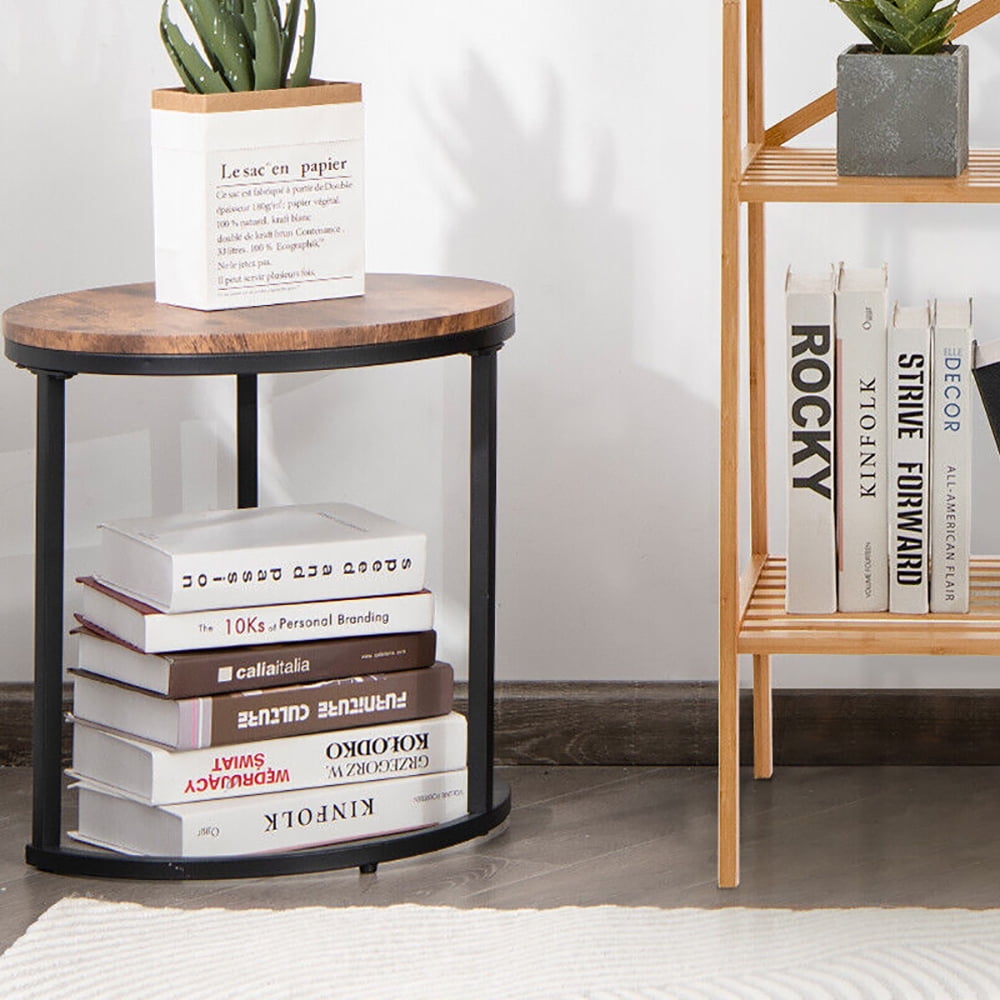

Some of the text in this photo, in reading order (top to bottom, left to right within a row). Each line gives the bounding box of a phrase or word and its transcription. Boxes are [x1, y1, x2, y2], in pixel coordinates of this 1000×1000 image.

[221, 163, 241, 179] Le
[271, 165, 289, 176] en
[301, 157, 348, 177] papier
[943, 357, 962, 432] DECOR
[791, 324, 832, 500] ROCKY
[859, 377, 877, 498] KINFOLK
[896, 353, 925, 586] STRIVE FORWARD
[944, 465, 957, 602] ALL-AMERICAN FLAIR
[182, 557, 412, 589] speed and passion
[199, 610, 390, 636] The 10Ks of Personal Branding
[237, 690, 407, 729] FURNITURE CULTURE
[211, 752, 266, 773] ŚWIAT
[325, 732, 430, 760] KOŁODKO
[184, 766, 291, 794] WĘDRUJĄCY
[347, 753, 430, 776] GRZEGORZ
[263, 797, 375, 832] KINFOLK
